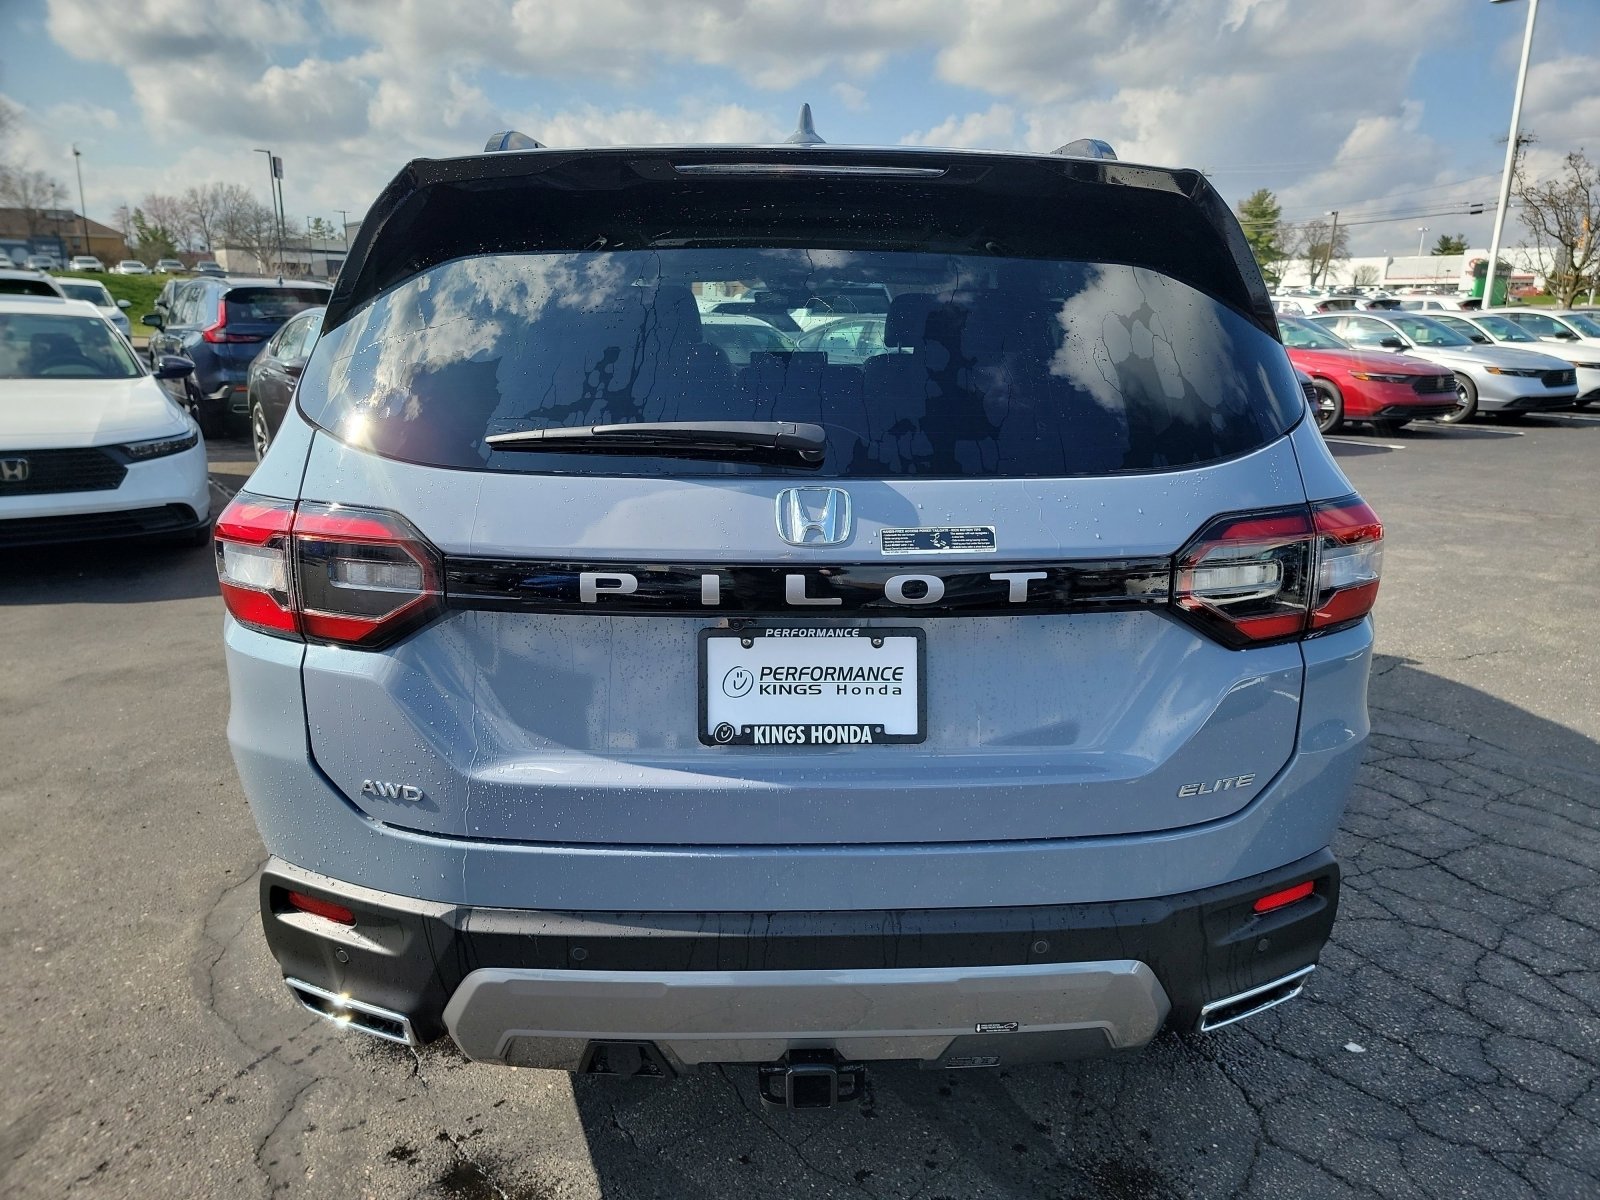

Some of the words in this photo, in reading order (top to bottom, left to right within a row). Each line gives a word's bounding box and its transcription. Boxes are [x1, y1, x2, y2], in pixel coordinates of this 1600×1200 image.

[579, 571, 1048, 606] PILOT
[765, 628, 860, 638] PERFORMANCE
[759, 666, 904, 682] PERFORMANCE
[759, 684, 822, 696] KINGS
[836, 684, 902, 696] Honda
[753, 725, 806, 745] KINGS
[810, 725, 873, 744] HONDA
[360, 779, 423, 802] AWD
[1178, 773, 1256, 798] ELITE
